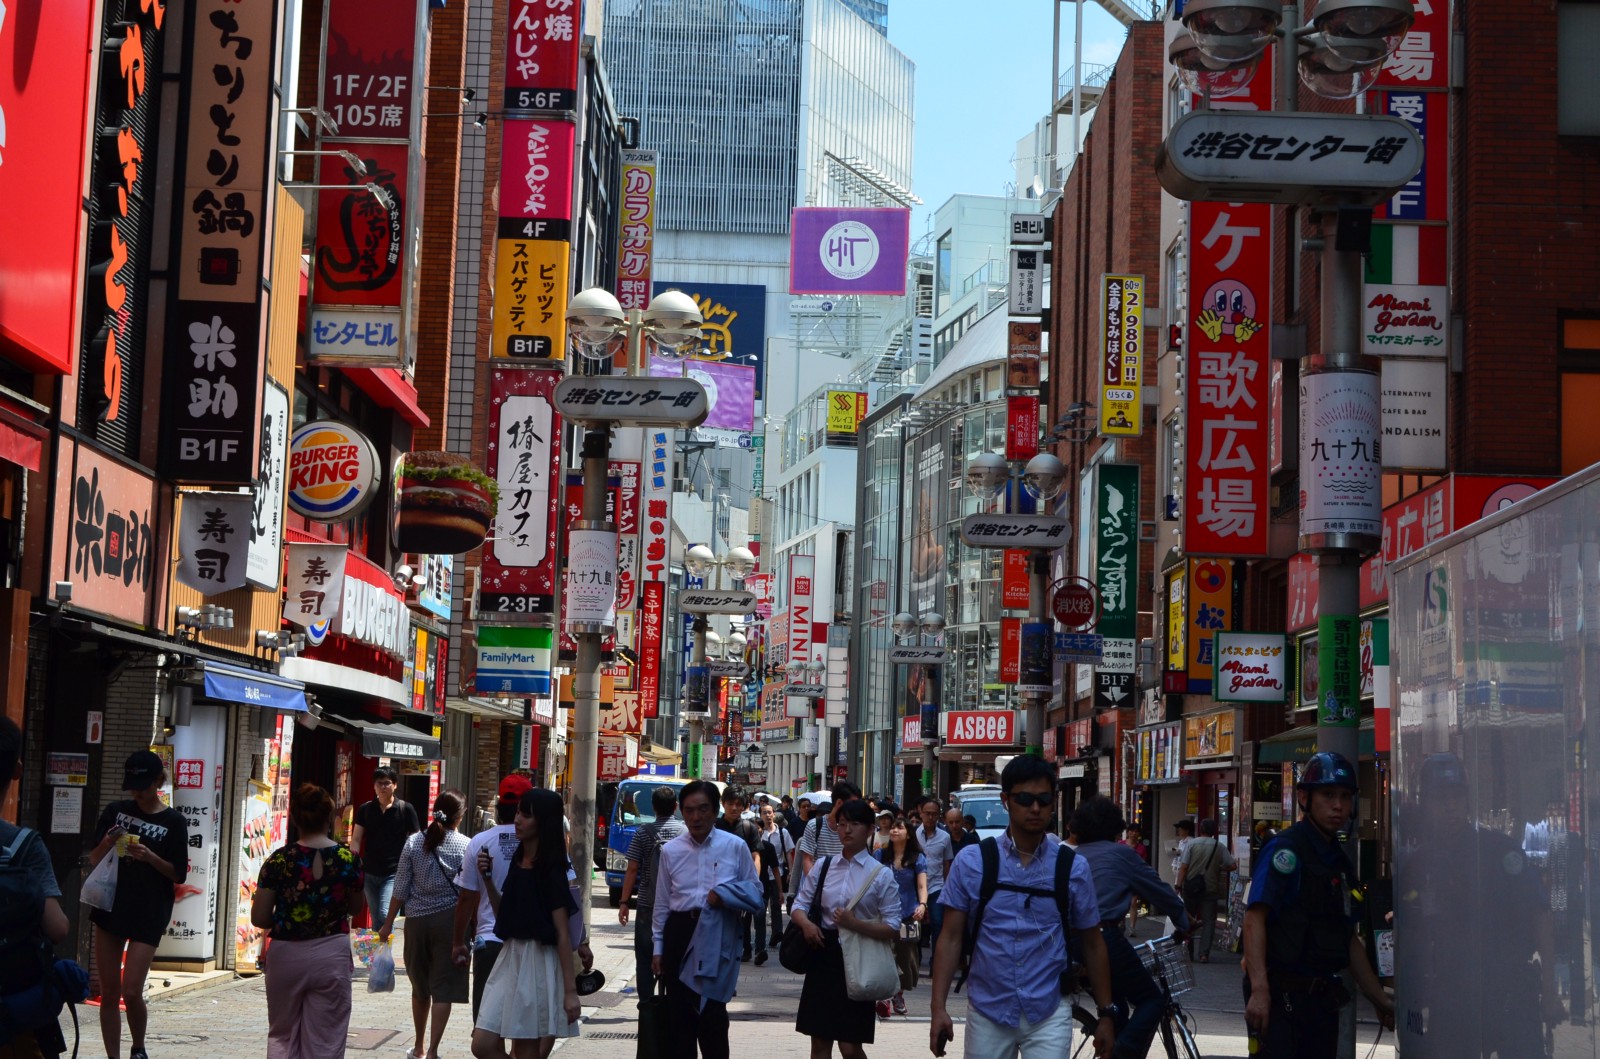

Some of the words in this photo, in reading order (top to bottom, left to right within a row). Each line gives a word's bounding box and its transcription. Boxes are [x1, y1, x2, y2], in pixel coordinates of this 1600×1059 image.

[332, 74, 407, 98] 1F/2F
[193, 9, 255, 238] ちりとり鍋
[333, 104, 403, 128] 105席
[1182, 131, 1408, 165] 渋谷センター街
[522, 221, 548, 237] 4F
[622, 167, 653, 277] カラオケ
[1013, 220, 1044, 235] 白馬ビル
[509, 243, 529, 332] スパゲッティ
[620, 280, 646, 292] 受付
[1025, 270, 1035, 304] 渋谷消費者
[1124, 279, 1139, 291] 60分
[1367, 293, 1432, 312] Miami
[313, 319, 398, 348] センタービル
[1107, 281, 1122, 382] 全身もみほぐし
[1366, 333, 1444, 347] マイアミガーデン
[514, 339, 545, 353] B1F
[188, 315, 239, 419] 米助
[562, 388, 699, 409] 渋谷センター街
[1108, 390, 1133, 400] りらくる
[1110, 402, 1130, 411] 渋谷店
[1382, 408, 1402, 416] CAFE
[179, 437, 239, 463] B1F
[1197, 349, 1259, 539] 歌広場
[1311, 436, 1382, 464] 九十九島
[290, 445, 359, 469] BURGER
[289, 460, 360, 491] KING
[506, 415, 544, 549] 椿屋カフェ
[620, 463, 638, 532] 野郎ラーメン
[967, 523, 1067, 538] 渋谷センター街
[194, 507, 234, 583] 寿司
[299, 556, 331, 616] 寿司
[568, 569, 613, 587] 九十九島
[1010, 586, 1027, 594] First
[683, 595, 753, 607] 渋谷センター街
[1056, 598, 1091, 614] 消火栓
[481, 652, 535, 664] FamilyMart
[892, 649, 945, 659] 渋谷センター街
[1220, 660, 1269, 675] Miami
[501, 679, 512, 690] 酒
[643, 677, 655, 685] 2F
[1100, 674, 1129, 686] B1F
[785, 686, 824, 694] 渋谷センター街
[953, 715, 1007, 740] ASBee
[177, 774, 202, 786] 寿司
